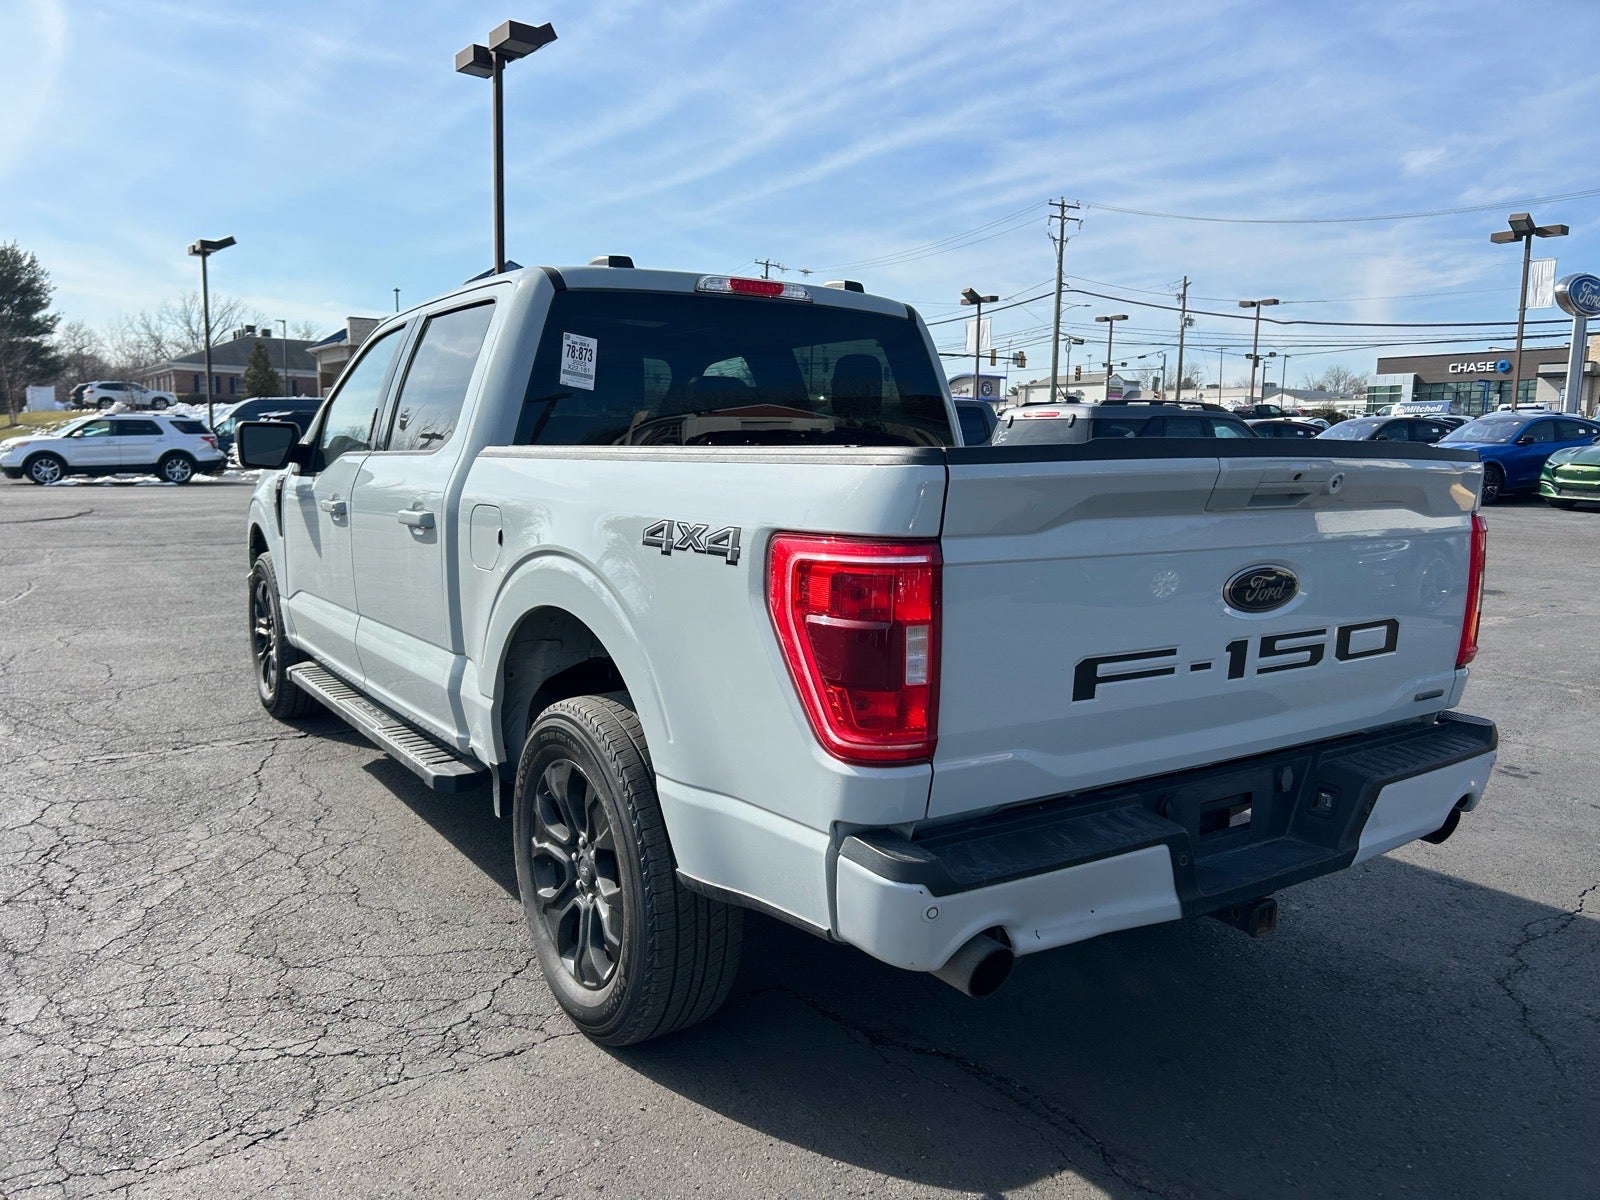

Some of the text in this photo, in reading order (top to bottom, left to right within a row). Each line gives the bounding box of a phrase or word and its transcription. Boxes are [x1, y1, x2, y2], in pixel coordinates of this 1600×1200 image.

[566, 344, 593, 362] 78:873
[1448, 361, 1496, 373] CHASE
[1404, 404, 1444, 413] Mitchell
[1245, 575, 1286, 602] Ford
[1072, 617, 1399, 702] F-150
